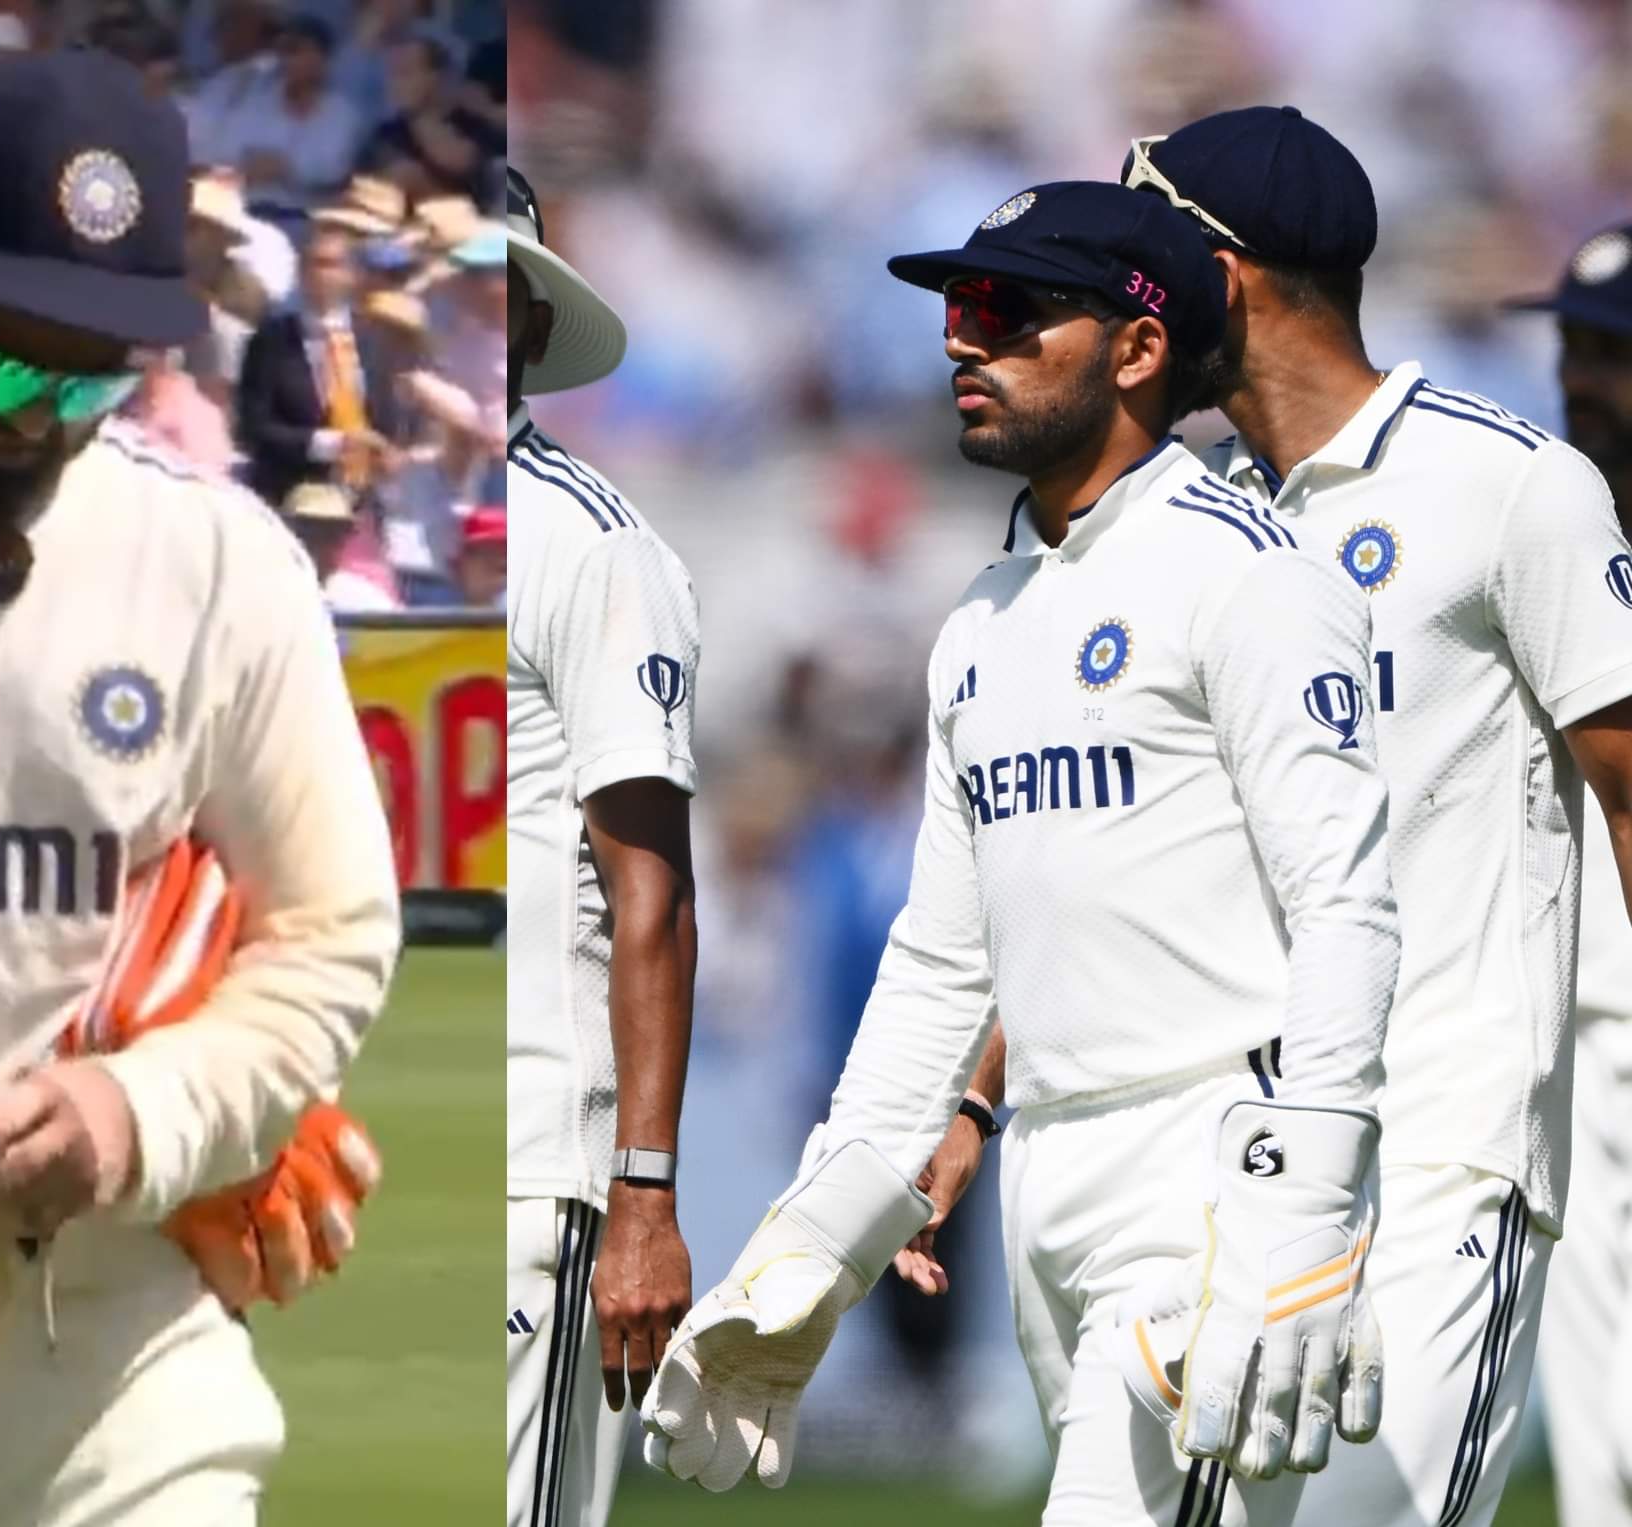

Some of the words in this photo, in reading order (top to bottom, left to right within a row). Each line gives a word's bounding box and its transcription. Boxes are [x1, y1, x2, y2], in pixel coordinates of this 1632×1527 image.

[1125, 271, 1166, 313] 312
[1082, 706, 1105, 721] 312
[957, 746, 1135, 835] REAM11
